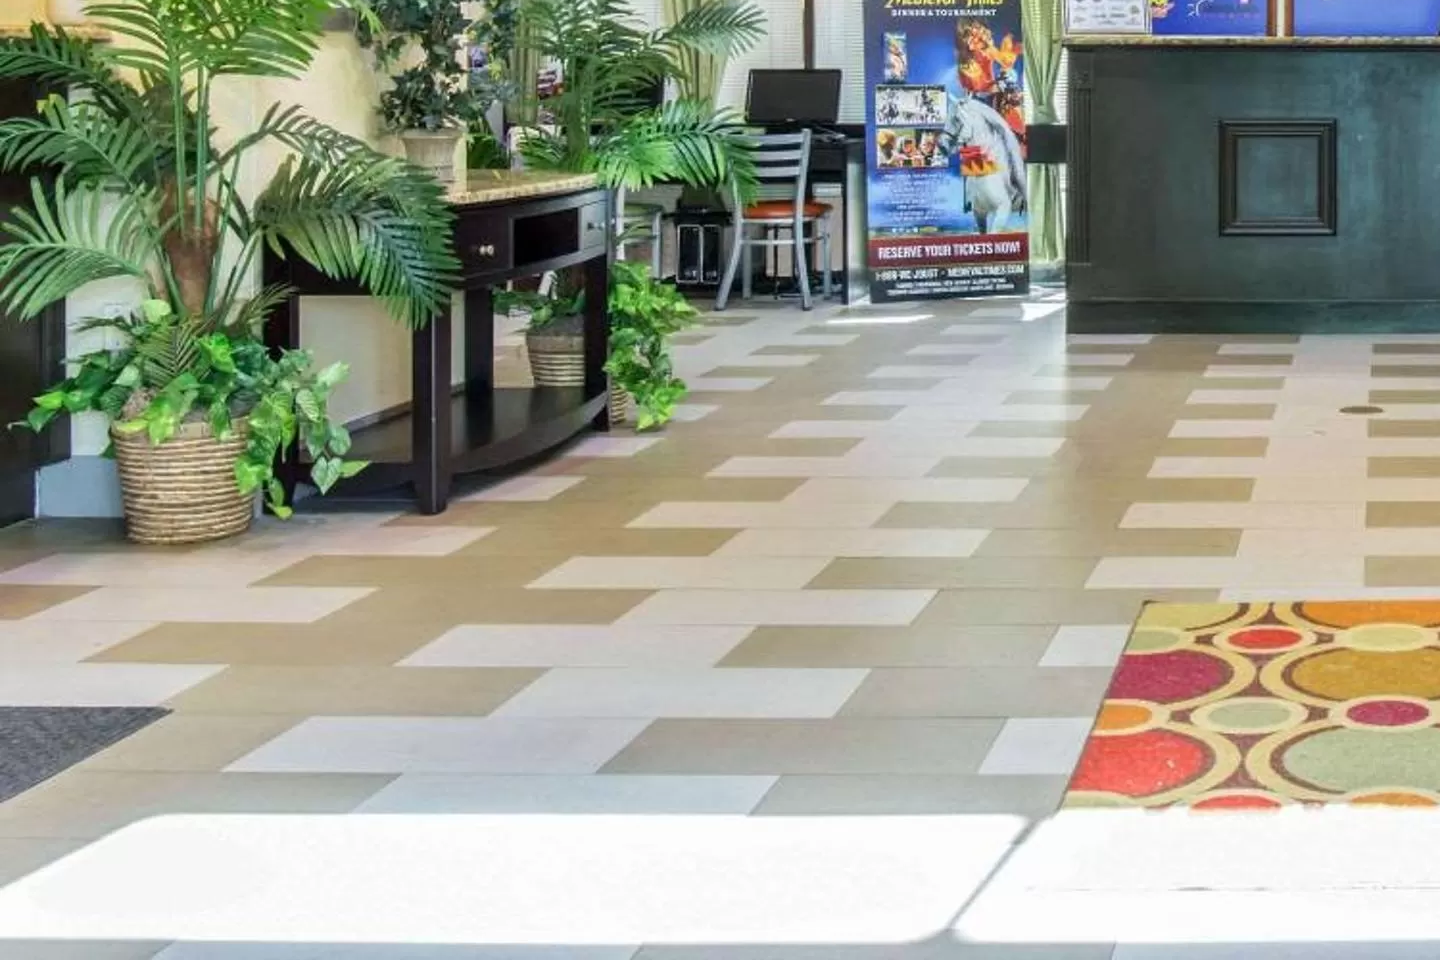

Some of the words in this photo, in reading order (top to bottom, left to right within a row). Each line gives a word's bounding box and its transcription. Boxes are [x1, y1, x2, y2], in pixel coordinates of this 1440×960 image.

[891, 9, 926, 17] DINNER
[936, 8, 997, 17] TOURNAMENT
[878, 246, 923, 260] RESERVE
[924, 244, 951, 257] YOUR
[953, 242, 993, 256] TICKETS
[994, 240, 1021, 254] NOW!
